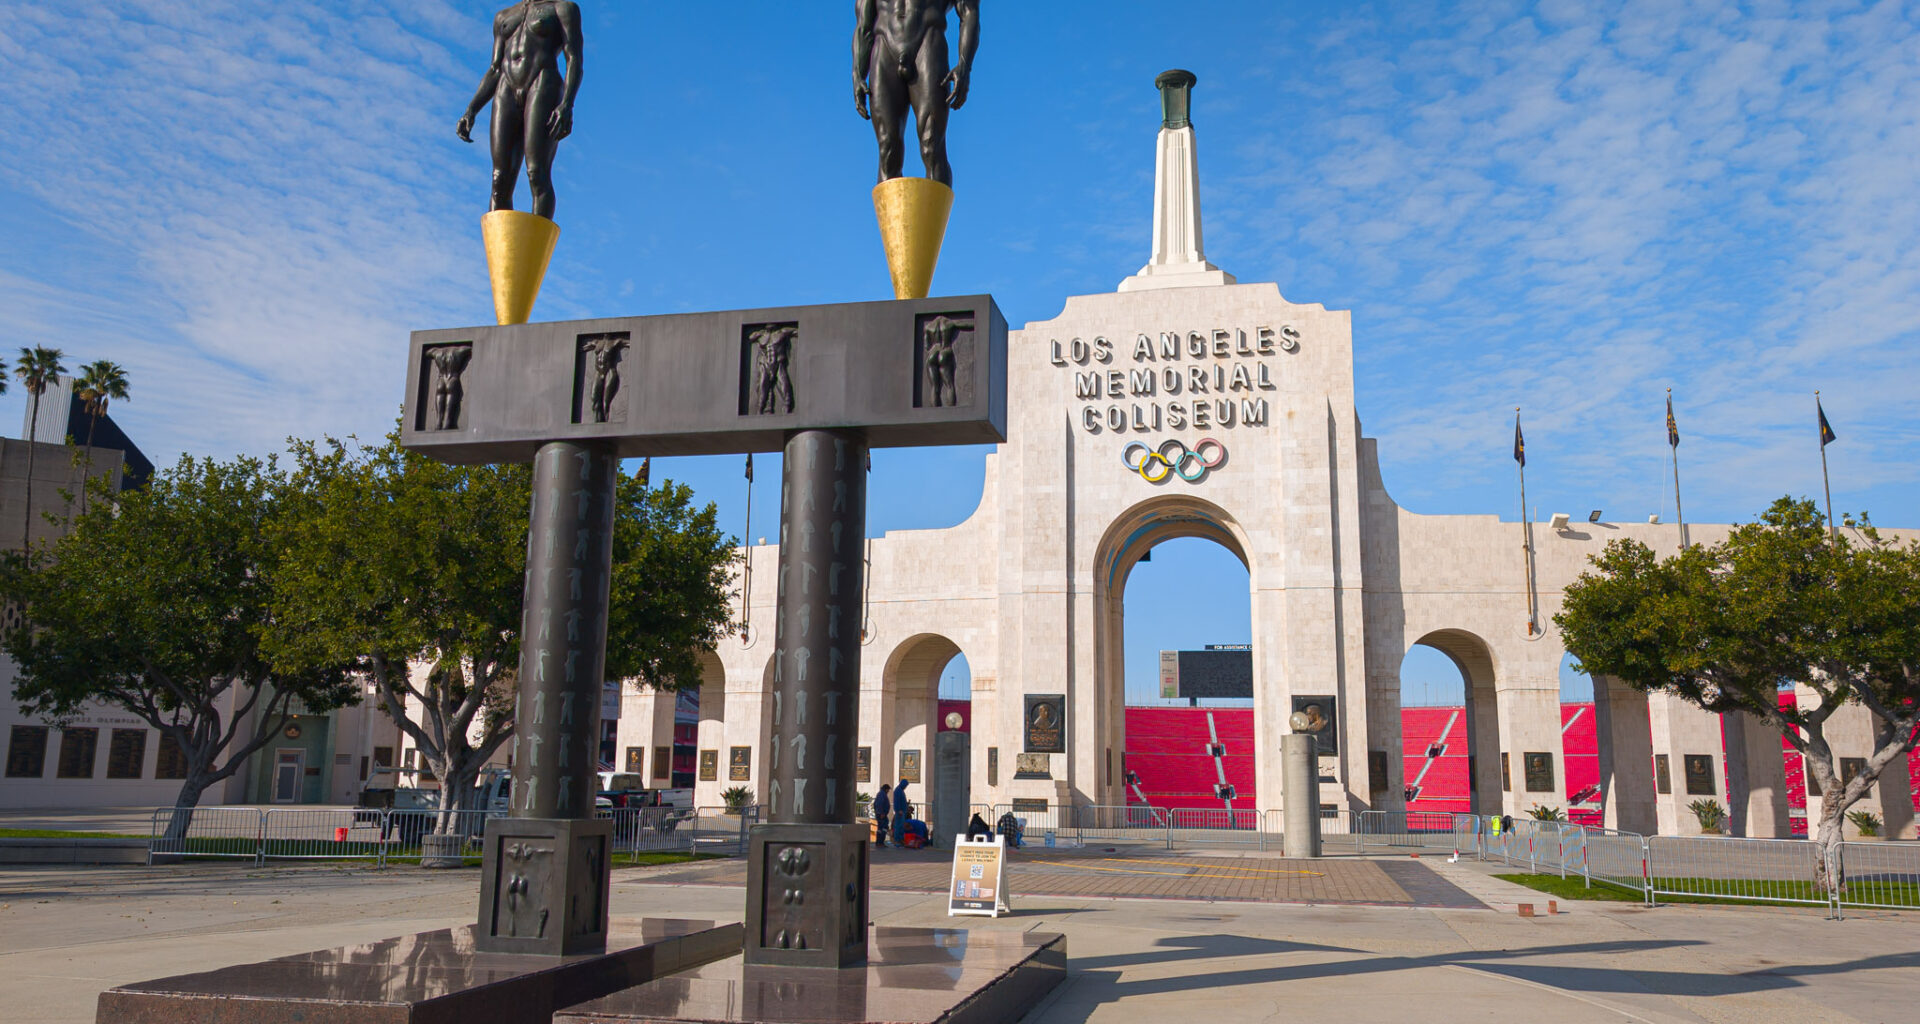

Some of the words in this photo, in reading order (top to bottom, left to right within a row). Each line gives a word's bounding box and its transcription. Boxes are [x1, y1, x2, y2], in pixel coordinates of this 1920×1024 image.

[1051, 336, 1111, 364] LOS
[1134, 325, 1298, 359] ANGELES
[1076, 361, 1273, 397] MEMORIAL
[1083, 397, 1267, 431] COLISEUM
